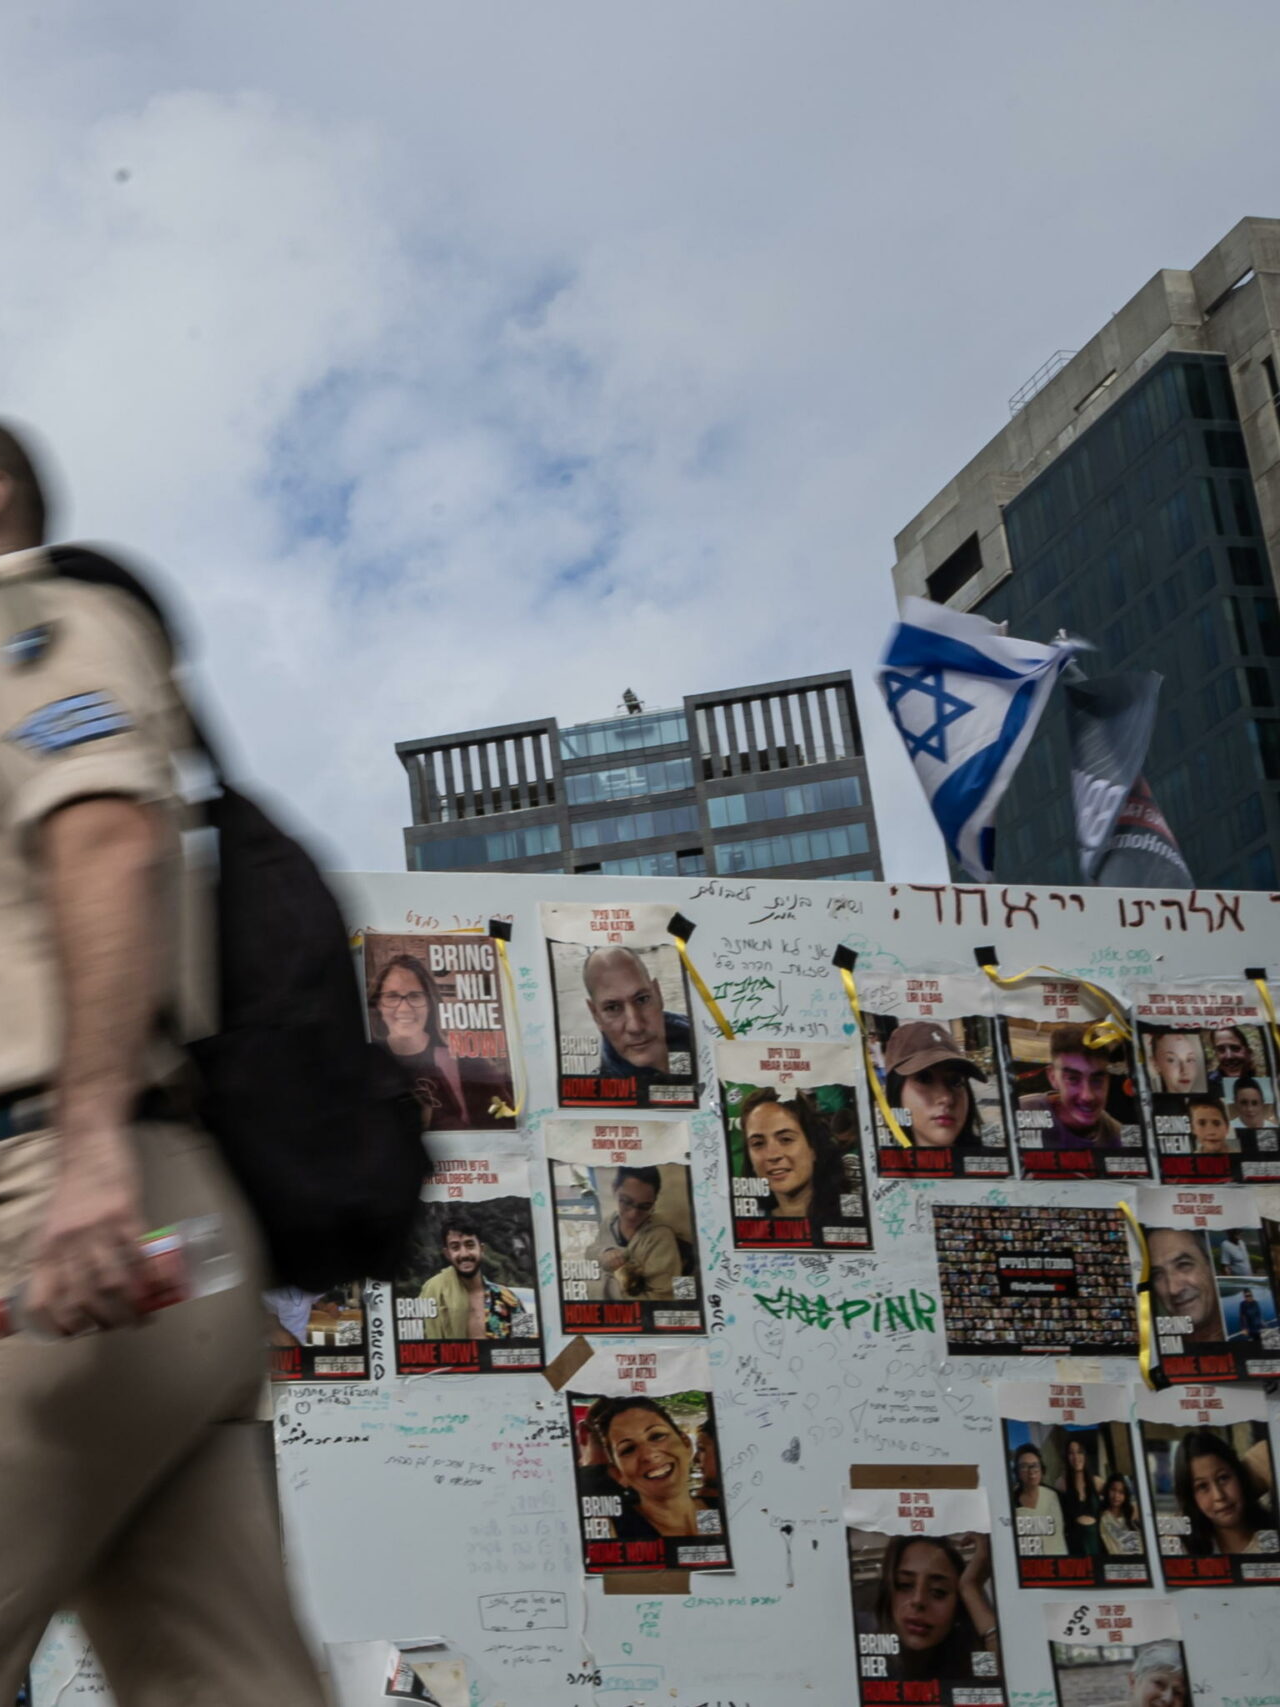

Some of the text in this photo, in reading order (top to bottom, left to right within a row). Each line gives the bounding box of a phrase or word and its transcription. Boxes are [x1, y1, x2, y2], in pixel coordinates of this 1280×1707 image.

[429, 944, 494, 972] BRING
[455, 974, 496, 1000] NILI
[438, 1002, 502, 1030] HOME
[448, 1032, 507, 1058] NOW!
[560, 1036, 598, 1054] BRING
[601, 1076, 637, 1098] NOW!
[1155, 1116, 1190, 1134] BRING
[1159, 1135, 1192, 1154] THEM
[434, 1173, 499, 1185] GOLDBERG-POLIN
[734, 1177, 770, 1196] BRING
[735, 1198, 759, 1217] HER
[562, 1260, 600, 1280] BRING
[563, 1281, 590, 1300] HER
[397, 1298, 438, 1318] BRING
[398, 1320, 424, 1340] HIM
[400, 1341, 479, 1364] HOME NOW!
[584, 1496, 622, 1517] BRING
[584, 1518, 612, 1539] HER
[626, 1540, 665, 1562] NOW!
[859, 1634, 900, 1655] BRING
[860, 1657, 888, 1677] HER
